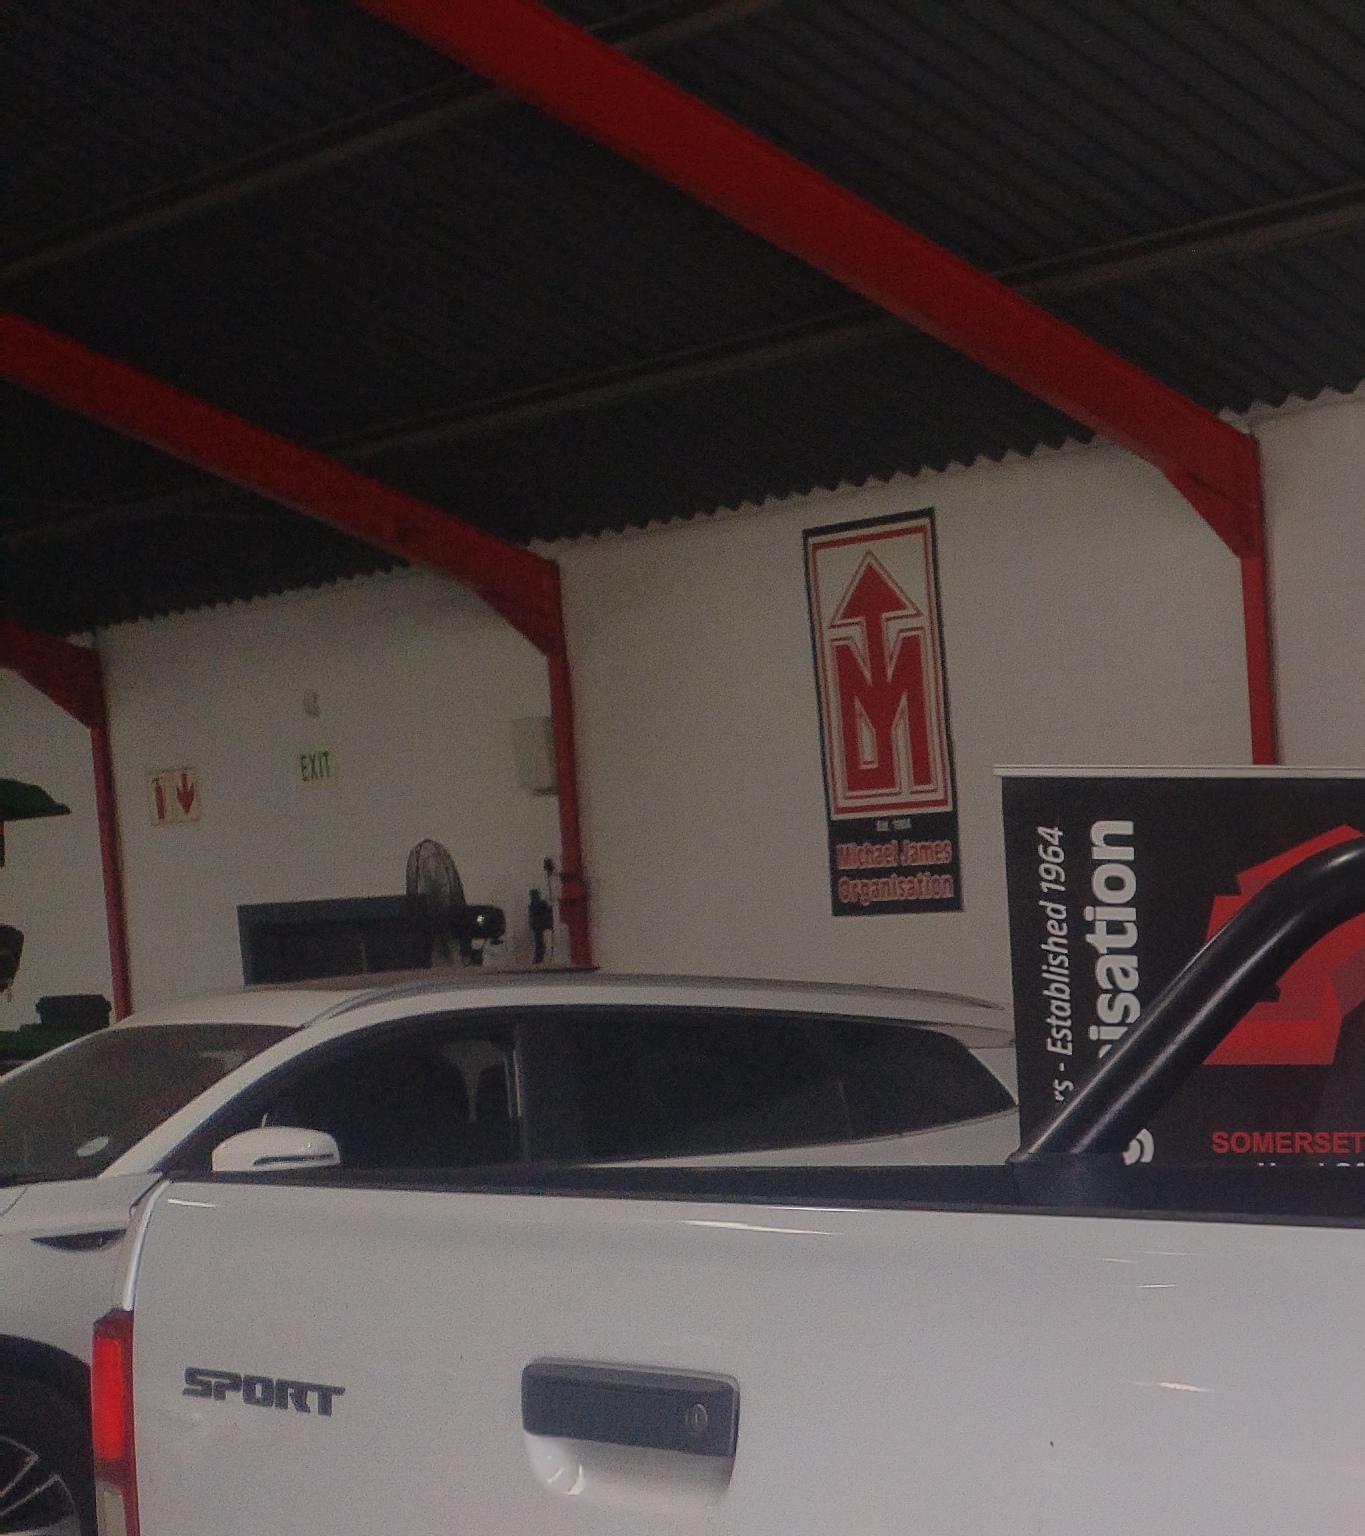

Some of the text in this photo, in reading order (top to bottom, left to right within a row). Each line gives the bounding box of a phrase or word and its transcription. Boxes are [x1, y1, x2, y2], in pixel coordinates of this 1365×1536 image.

[300, 750, 330, 781] EXIT
[1036, 826, 1066, 892] 1964
[838, 871, 955, 906] Organisation
[1083, 820, 1142, 1058] isation
[1037, 900, 1073, 1056] Established
[1211, 1130, 1365, 1154] SOMERSET
[182, 1366, 346, 1417] SPORT
